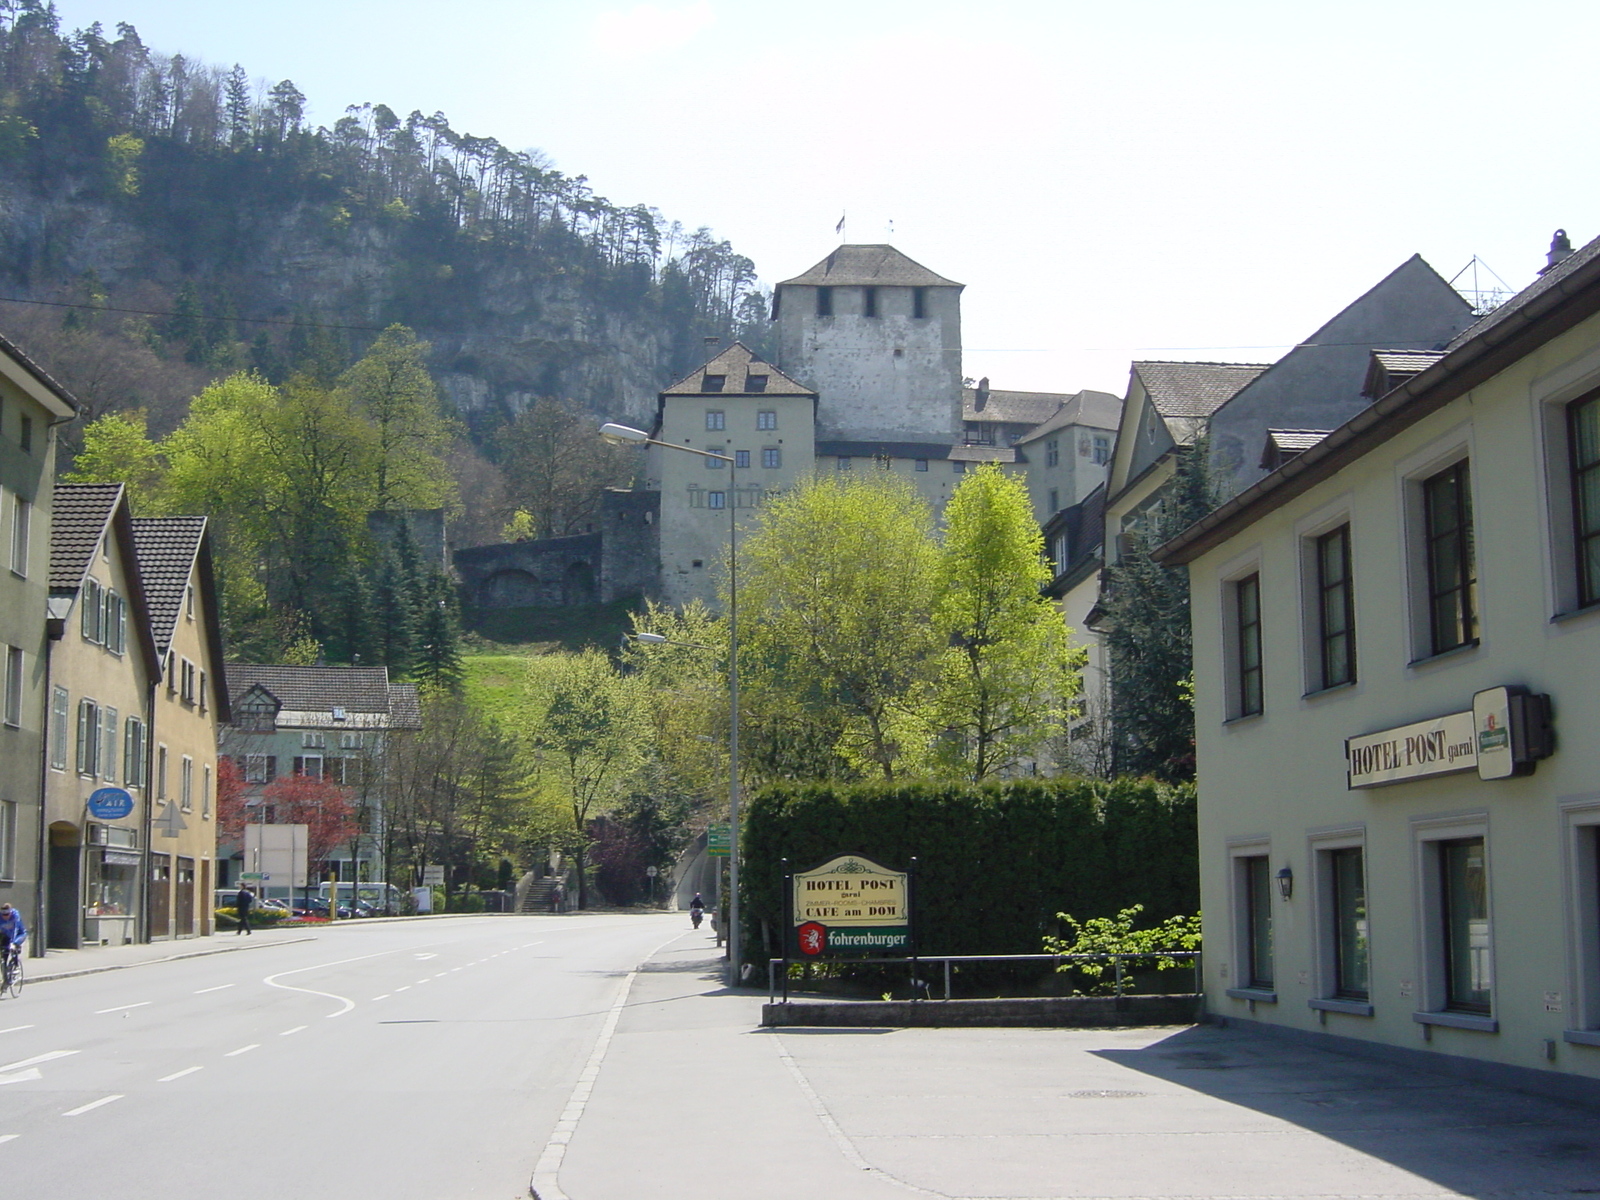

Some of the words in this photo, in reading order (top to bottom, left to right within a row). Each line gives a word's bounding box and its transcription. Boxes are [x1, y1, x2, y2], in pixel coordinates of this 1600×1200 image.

[1351, 740, 1401, 776] HOTEL
[1405, 729, 1446, 766] POST
[1448, 736, 1474, 764] garni
[806, 880, 853, 891] HOTEL
[861, 879, 896, 890] POST
[806, 907, 839, 917] CAFE
[844, 908, 862, 916] am
[869, 906, 896, 916] DOM
[828, 931, 906, 947] fohrenburger
